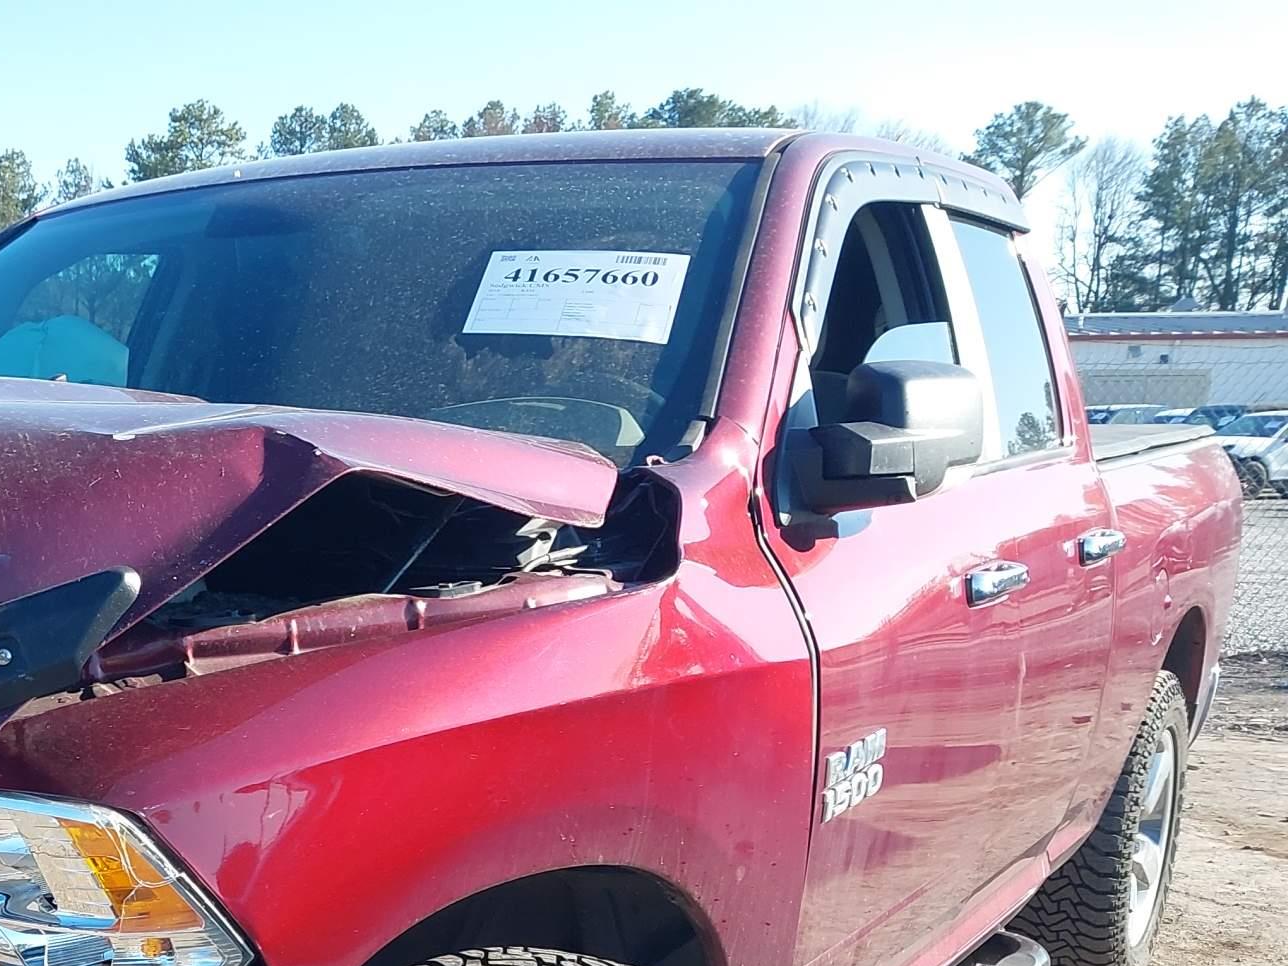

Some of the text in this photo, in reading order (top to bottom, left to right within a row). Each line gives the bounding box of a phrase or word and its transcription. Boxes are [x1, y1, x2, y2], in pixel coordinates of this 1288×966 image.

[503, 267, 660, 287] 41657660
[823, 728, 887, 791] RAM
[821, 763, 884, 824] 1500
